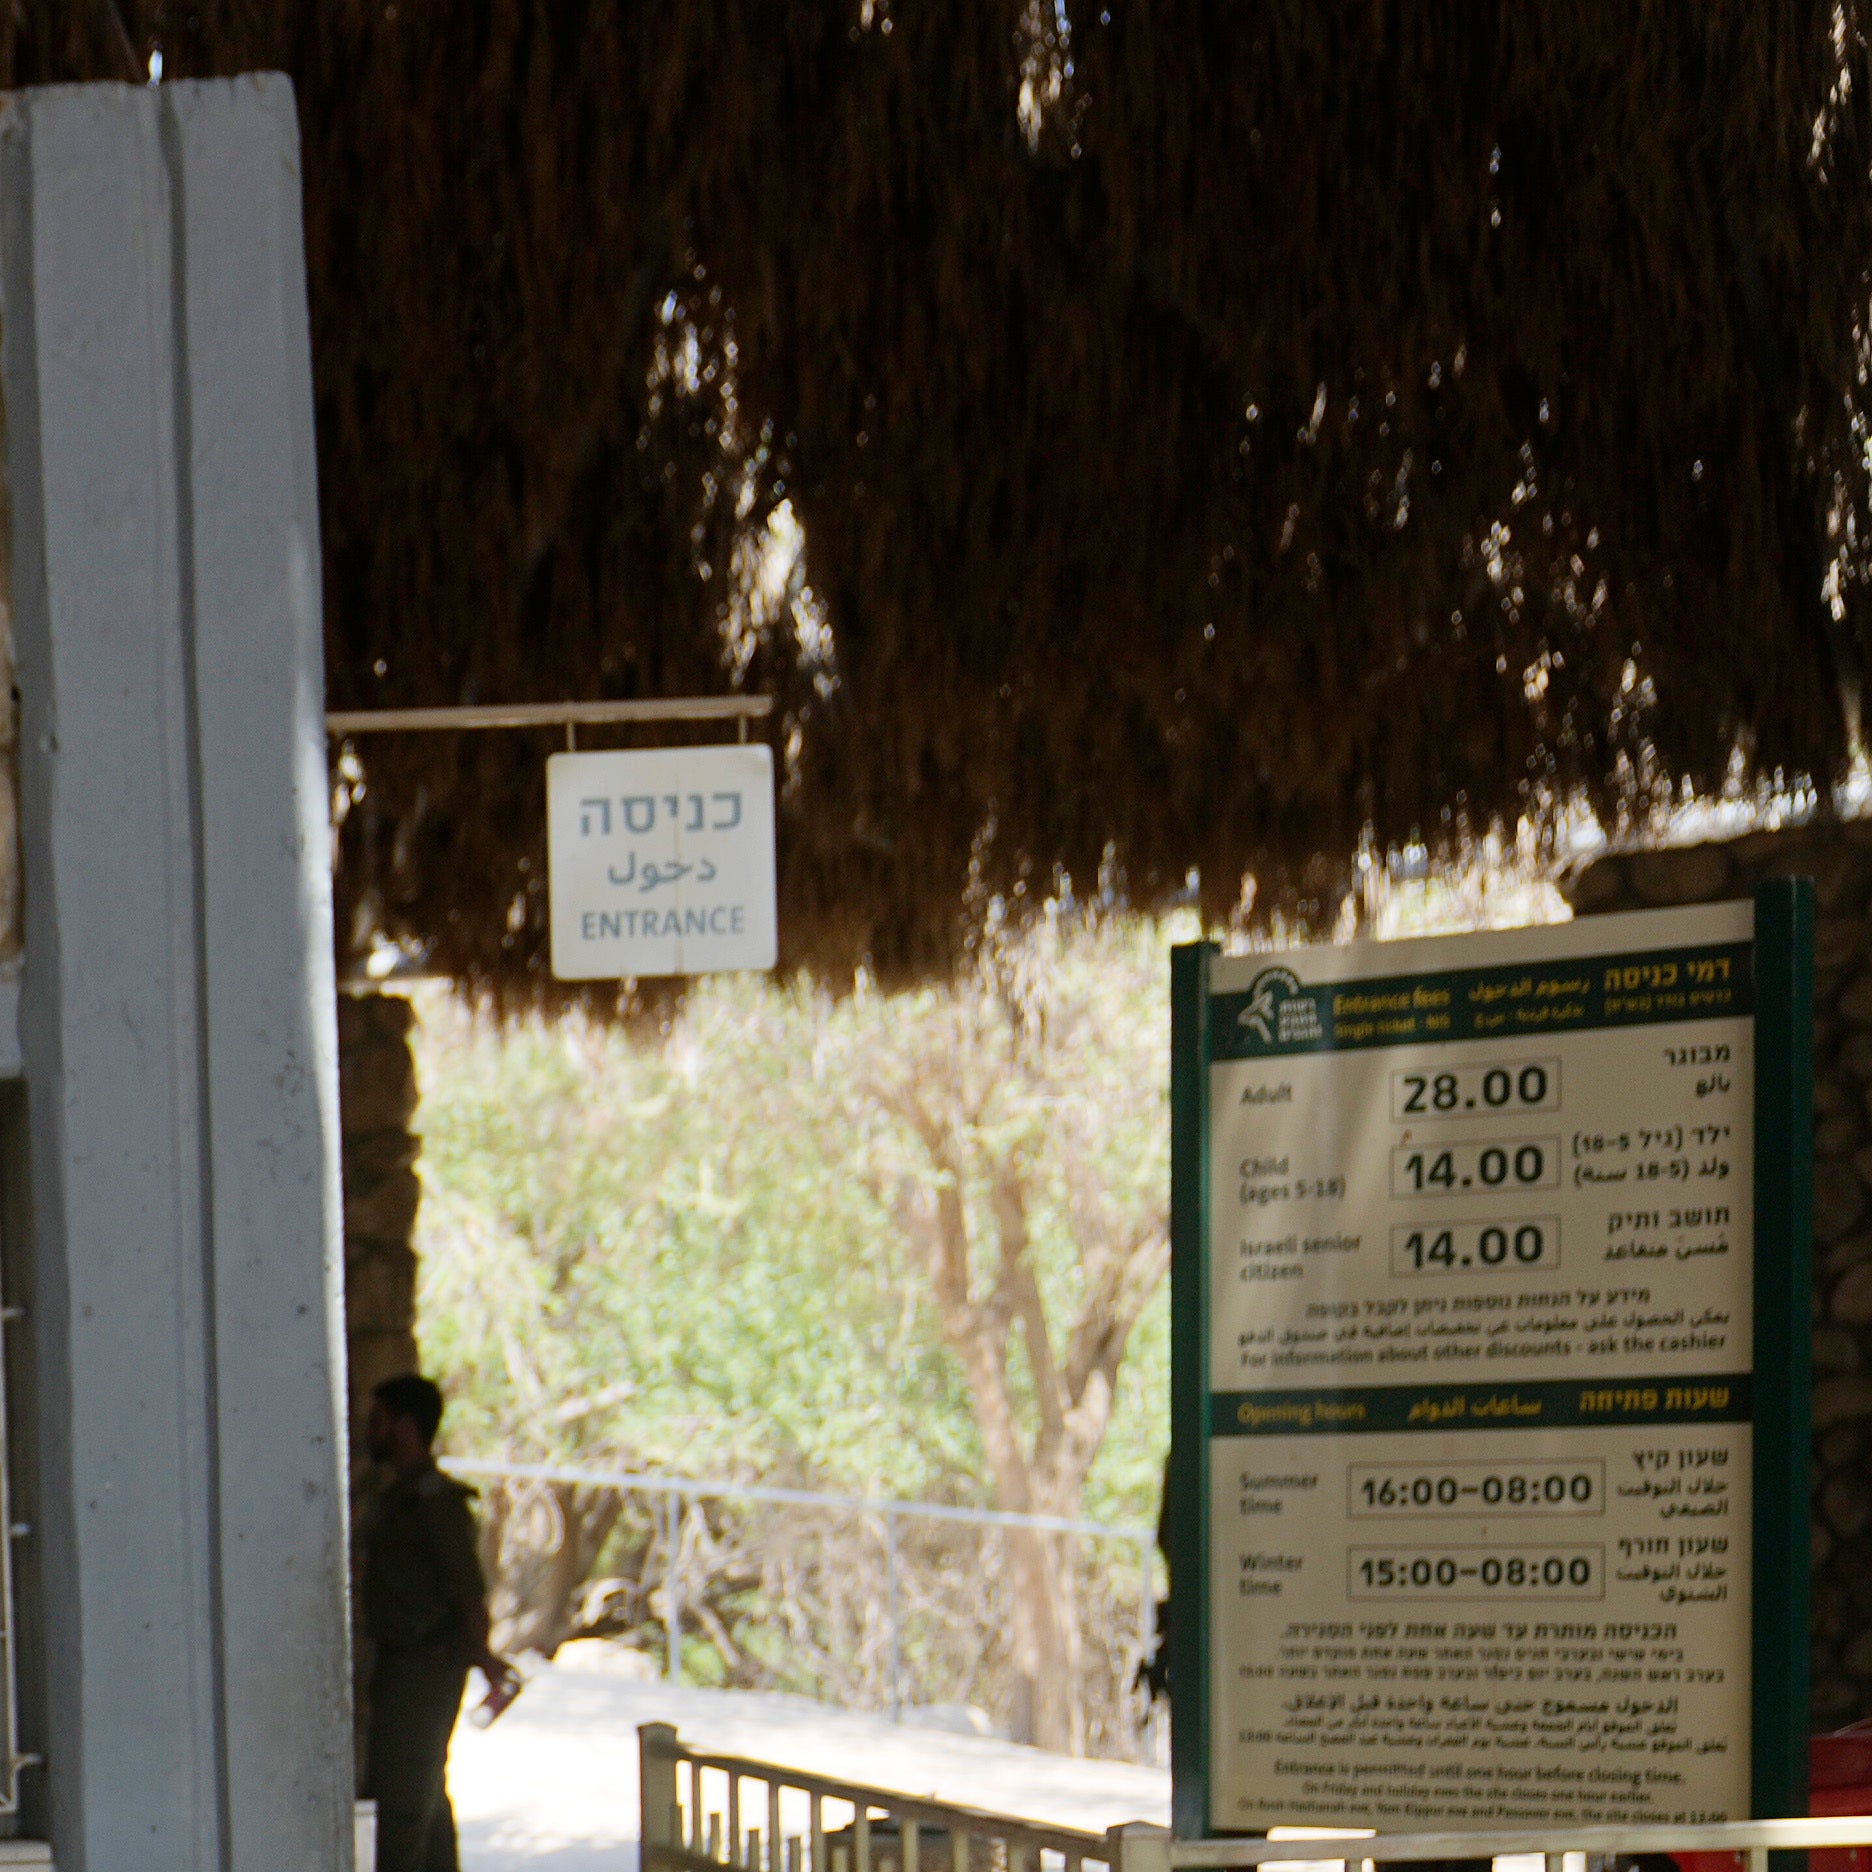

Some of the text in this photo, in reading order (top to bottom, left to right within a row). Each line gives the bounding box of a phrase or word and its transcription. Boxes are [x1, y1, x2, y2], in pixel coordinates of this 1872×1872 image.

[579, 791, 742, 837] כניסה
[581, 905, 745, 941] ENTRANCE
[1604, 958, 1730, 991] דמי כניסה
[1662, 1043, 1729, 1067] מבוגר
[1240, 1082, 1291, 1106] Adult
[1403, 1065, 1547, 1113] 28.00
[1691, 1123, 1729, 1146] ילד
[1239, 1155, 1289, 1178] Child
[1404, 1145, 1543, 1191] 14.00
[1608, 1207, 1729, 1235] תושב ותיק
[1404, 1224, 1543, 1269] 14.00
[1587, 1337, 1616, 1353] ask
[1623, 1334, 1653, 1352] the
[1659, 1330, 1725, 1350] cashier
[1579, 1385, 1729, 1412] שעות פתיחה
[1632, 1447, 1728, 1470] שעון קיץ
[1618, 1536, 1728, 1557] שעון חורף
[1503, 1622, 1526, 1639] עד
[1533, 1622, 1596, 1639] מותרת
[1604, 1622, 1677, 1639] הכניסה
